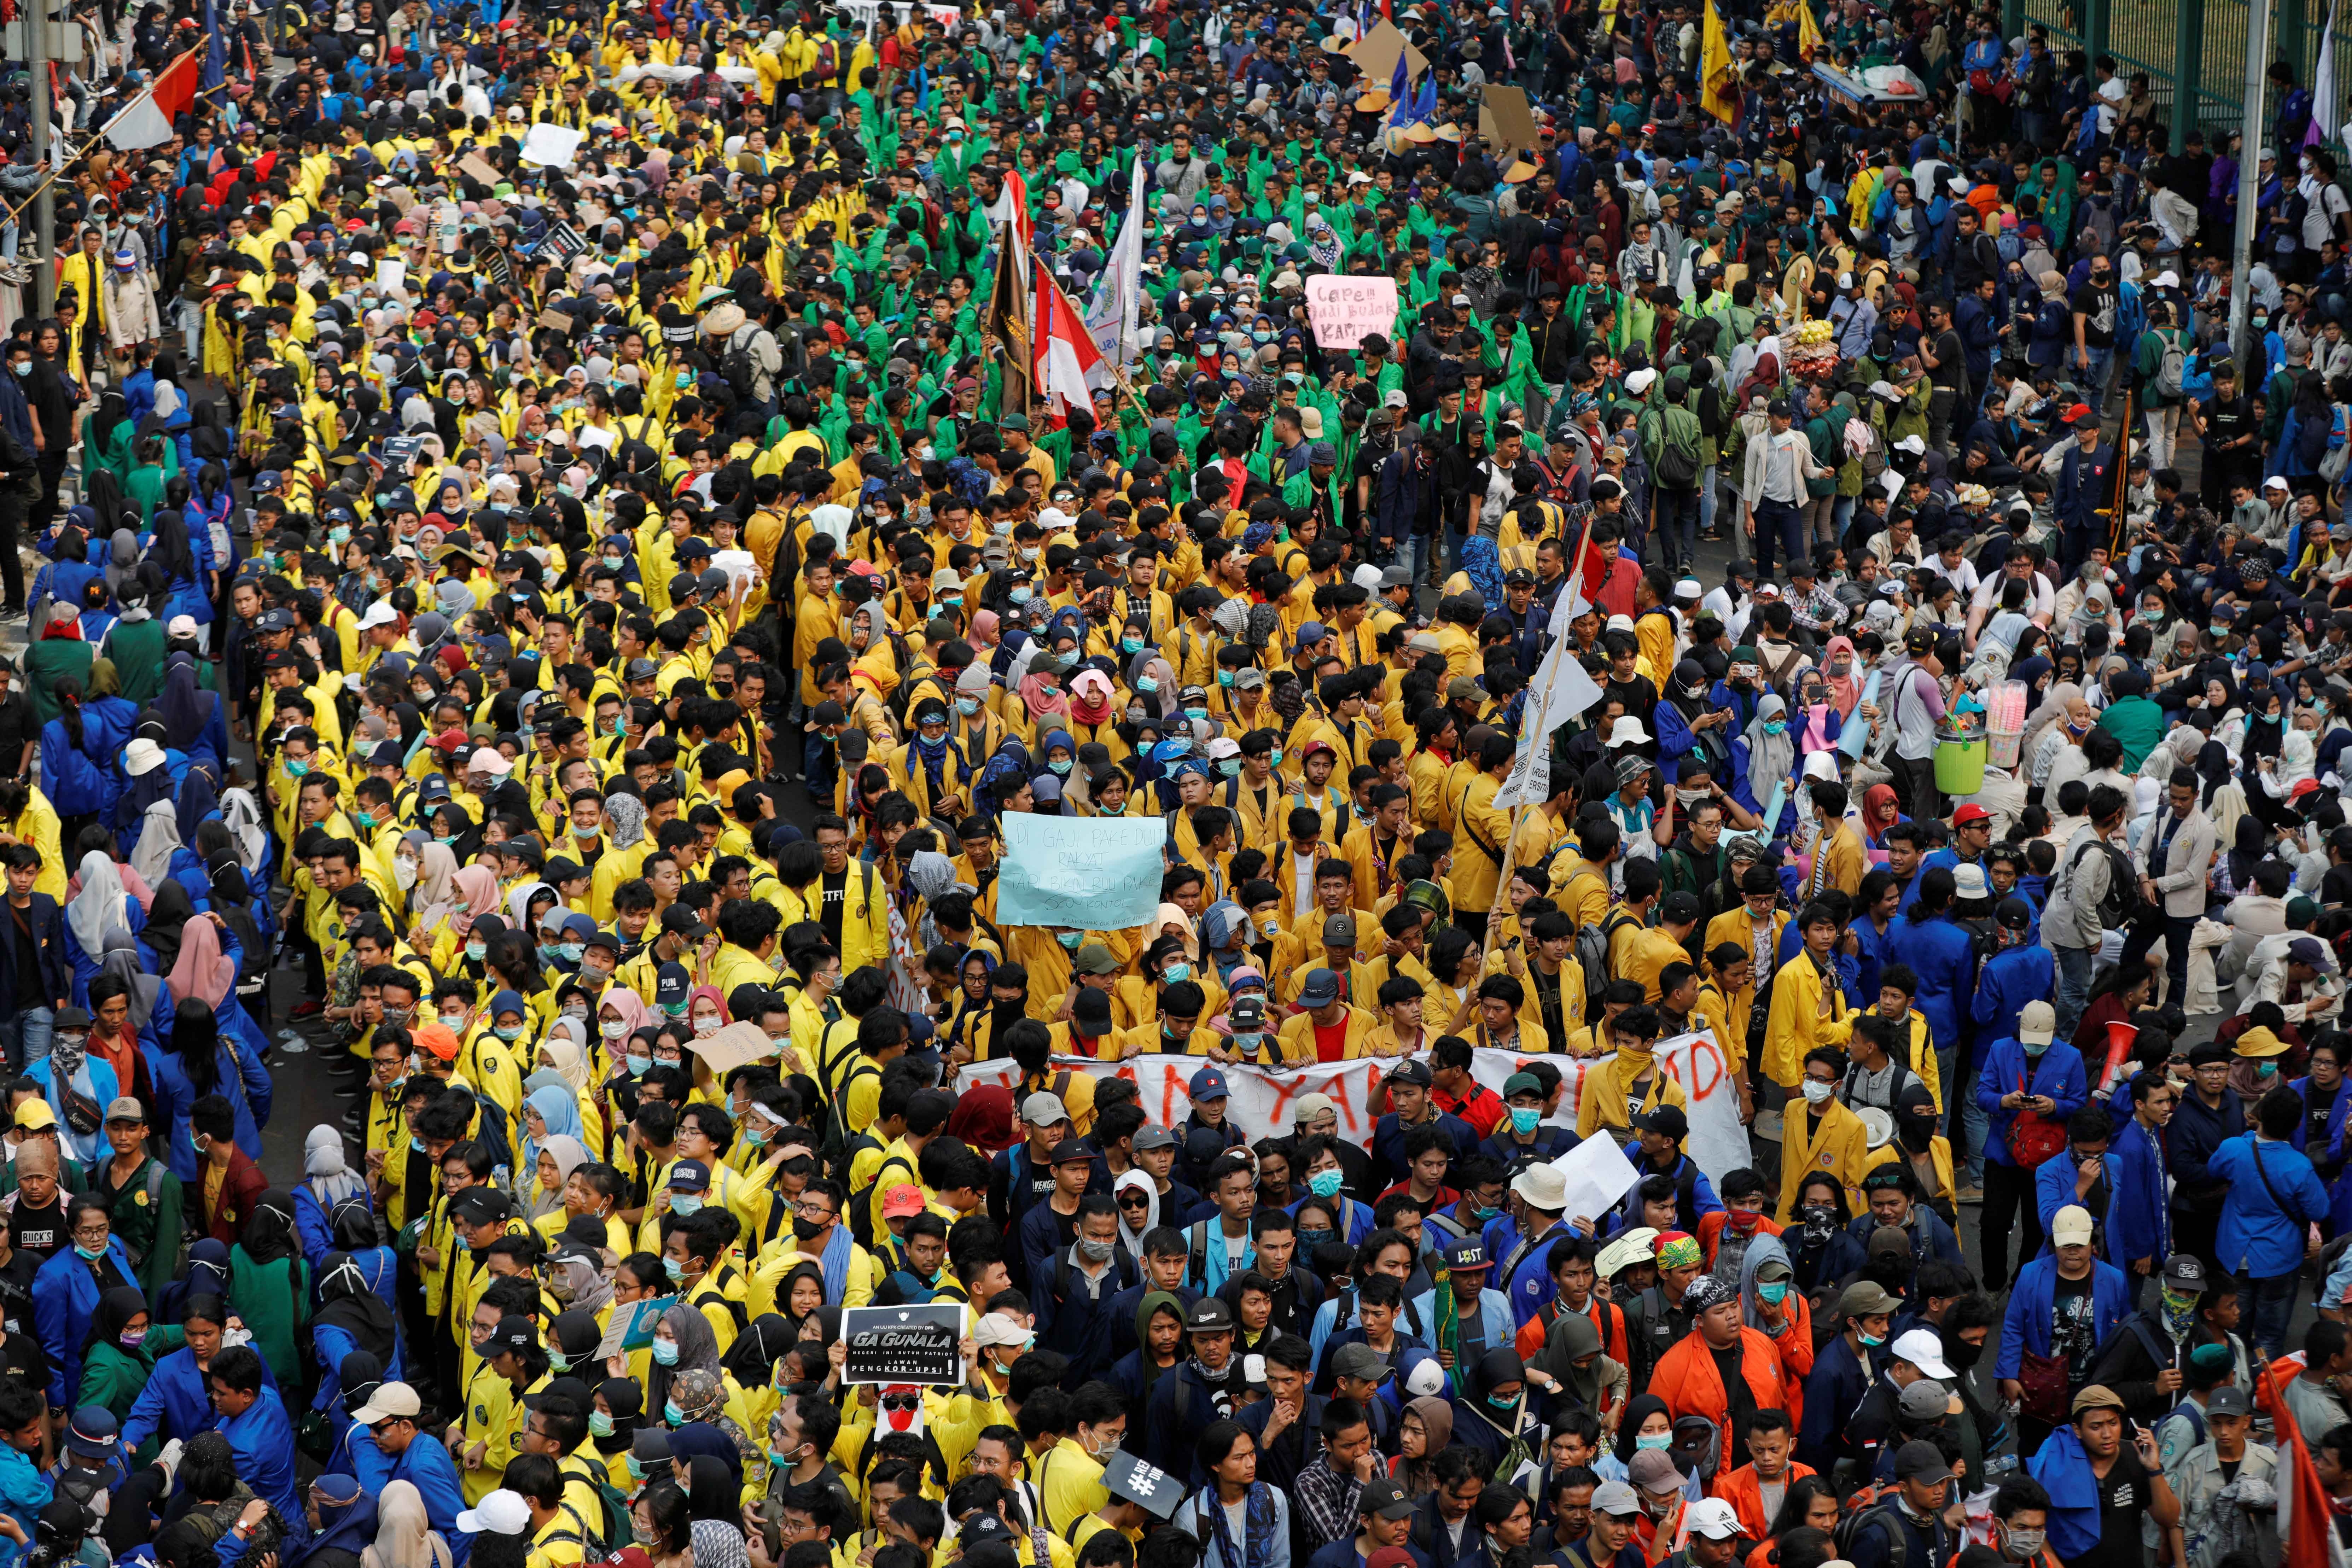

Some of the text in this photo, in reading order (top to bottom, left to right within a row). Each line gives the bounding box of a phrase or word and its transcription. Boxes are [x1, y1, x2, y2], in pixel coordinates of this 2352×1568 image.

[1043, 827, 1079, 847] GAJI
[1091, 828, 1127, 846] PAKE
[1059, 852, 1108, 869] RAKYAT
[1008, 873, 1155, 891] TAPI BIKIN RUU PAKE
[1087, 898, 1127, 910] KONTOL
[23, 1231, 52, 1242] BUCK'S
[853, 1331, 952, 1348] GA GUNALA
